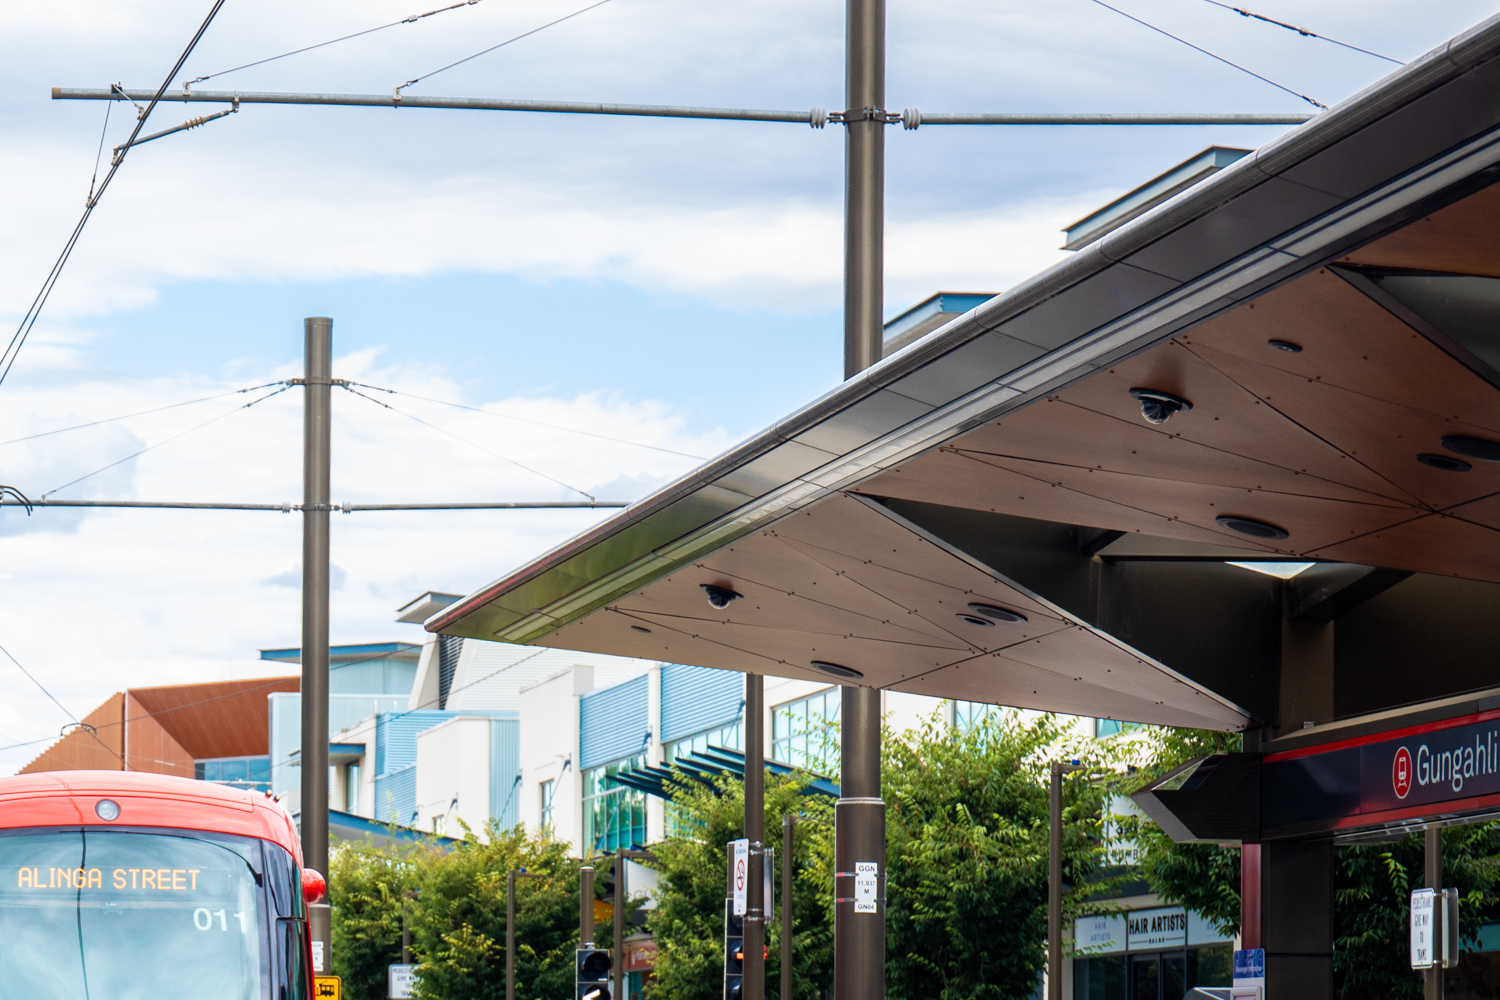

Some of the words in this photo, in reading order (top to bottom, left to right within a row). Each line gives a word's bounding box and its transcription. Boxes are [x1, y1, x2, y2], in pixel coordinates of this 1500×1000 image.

[18, 866, 102, 889] ALINGA
[113, 868, 200, 890] STREET
[192, 907, 248, 934] 011
[1129, 917, 1149, 935] HAIR
[1151, 913, 1185, 932] ARTISTS
